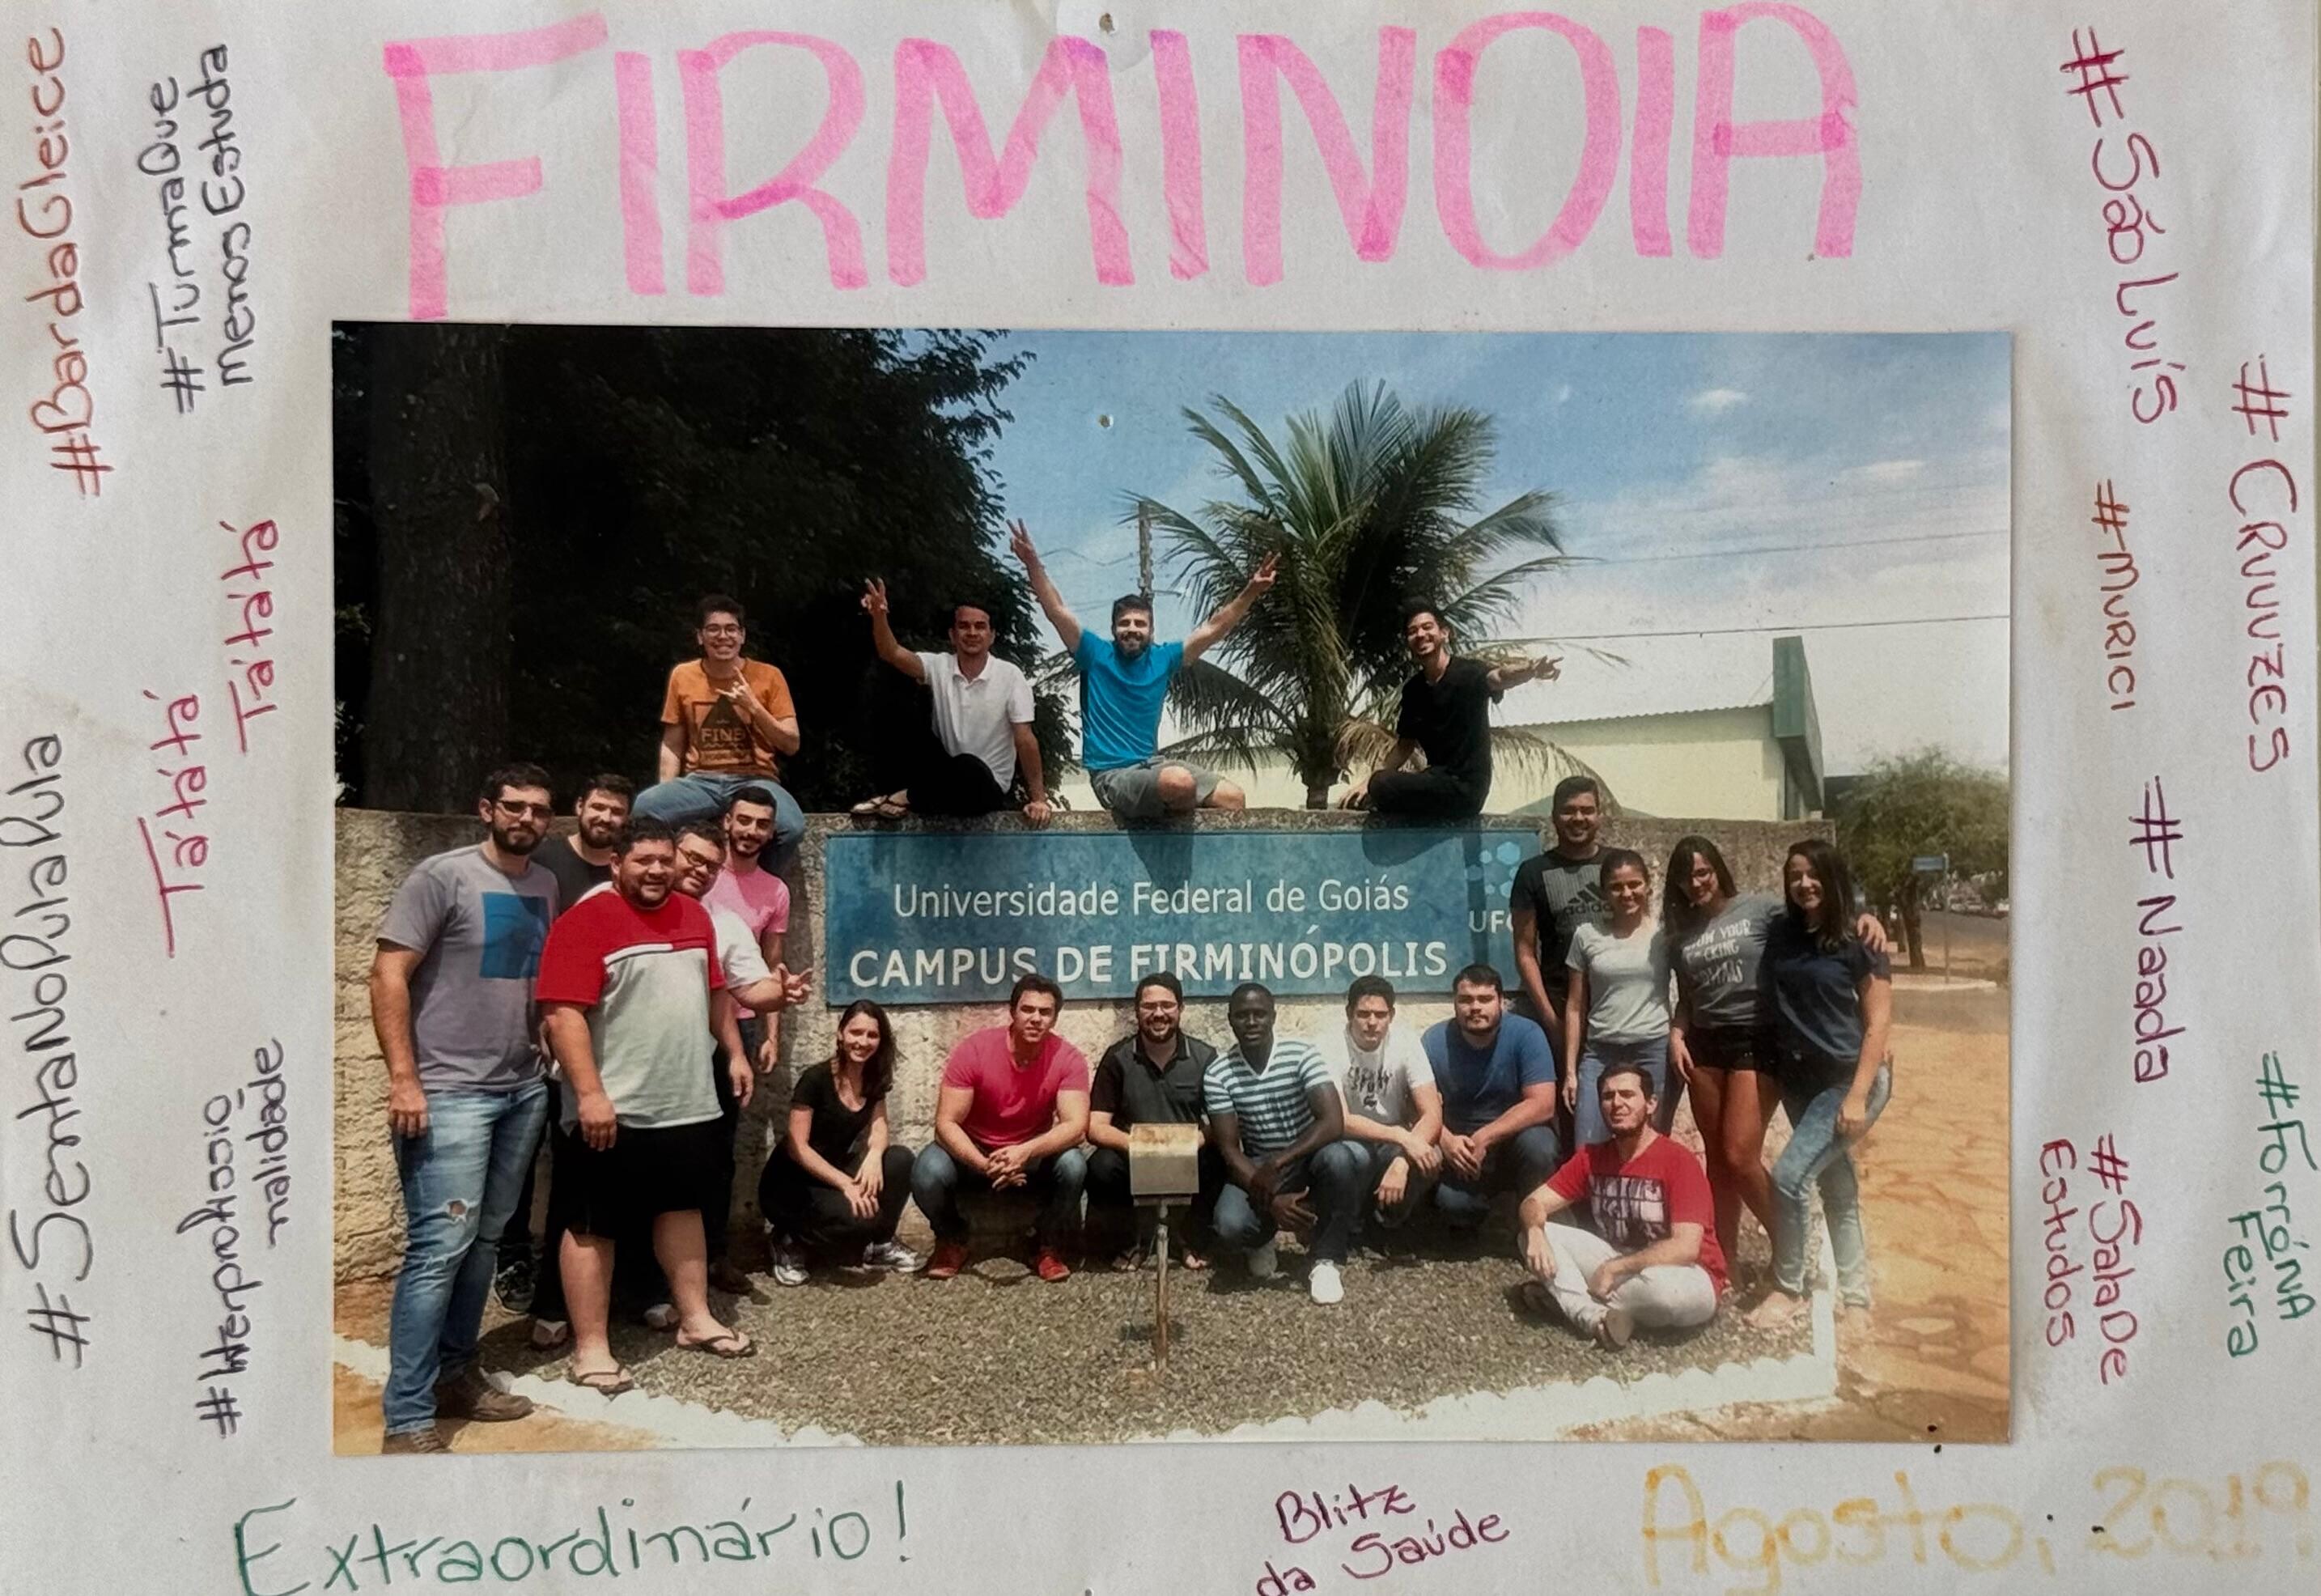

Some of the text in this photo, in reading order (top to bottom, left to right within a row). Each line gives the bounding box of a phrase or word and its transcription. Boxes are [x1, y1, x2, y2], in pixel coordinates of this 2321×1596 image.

[384, 2, 1863, 319] FIRMINOIA
[137, 76, 206, 414] #TurmaQue
[895, 874, 1409, 918] Universidade Federal de Goiás
[850, 924, 1447, 987] CAMPUS DE FIRMINÓPOLIS
[2039, 1138, 2085, 1348] Estudos
[2223, 1211, 2274, 1359] Feira
[1256, 1509, 1510, 1596] da Saúde
[1275, 1484, 1416, 1543] Blitz
